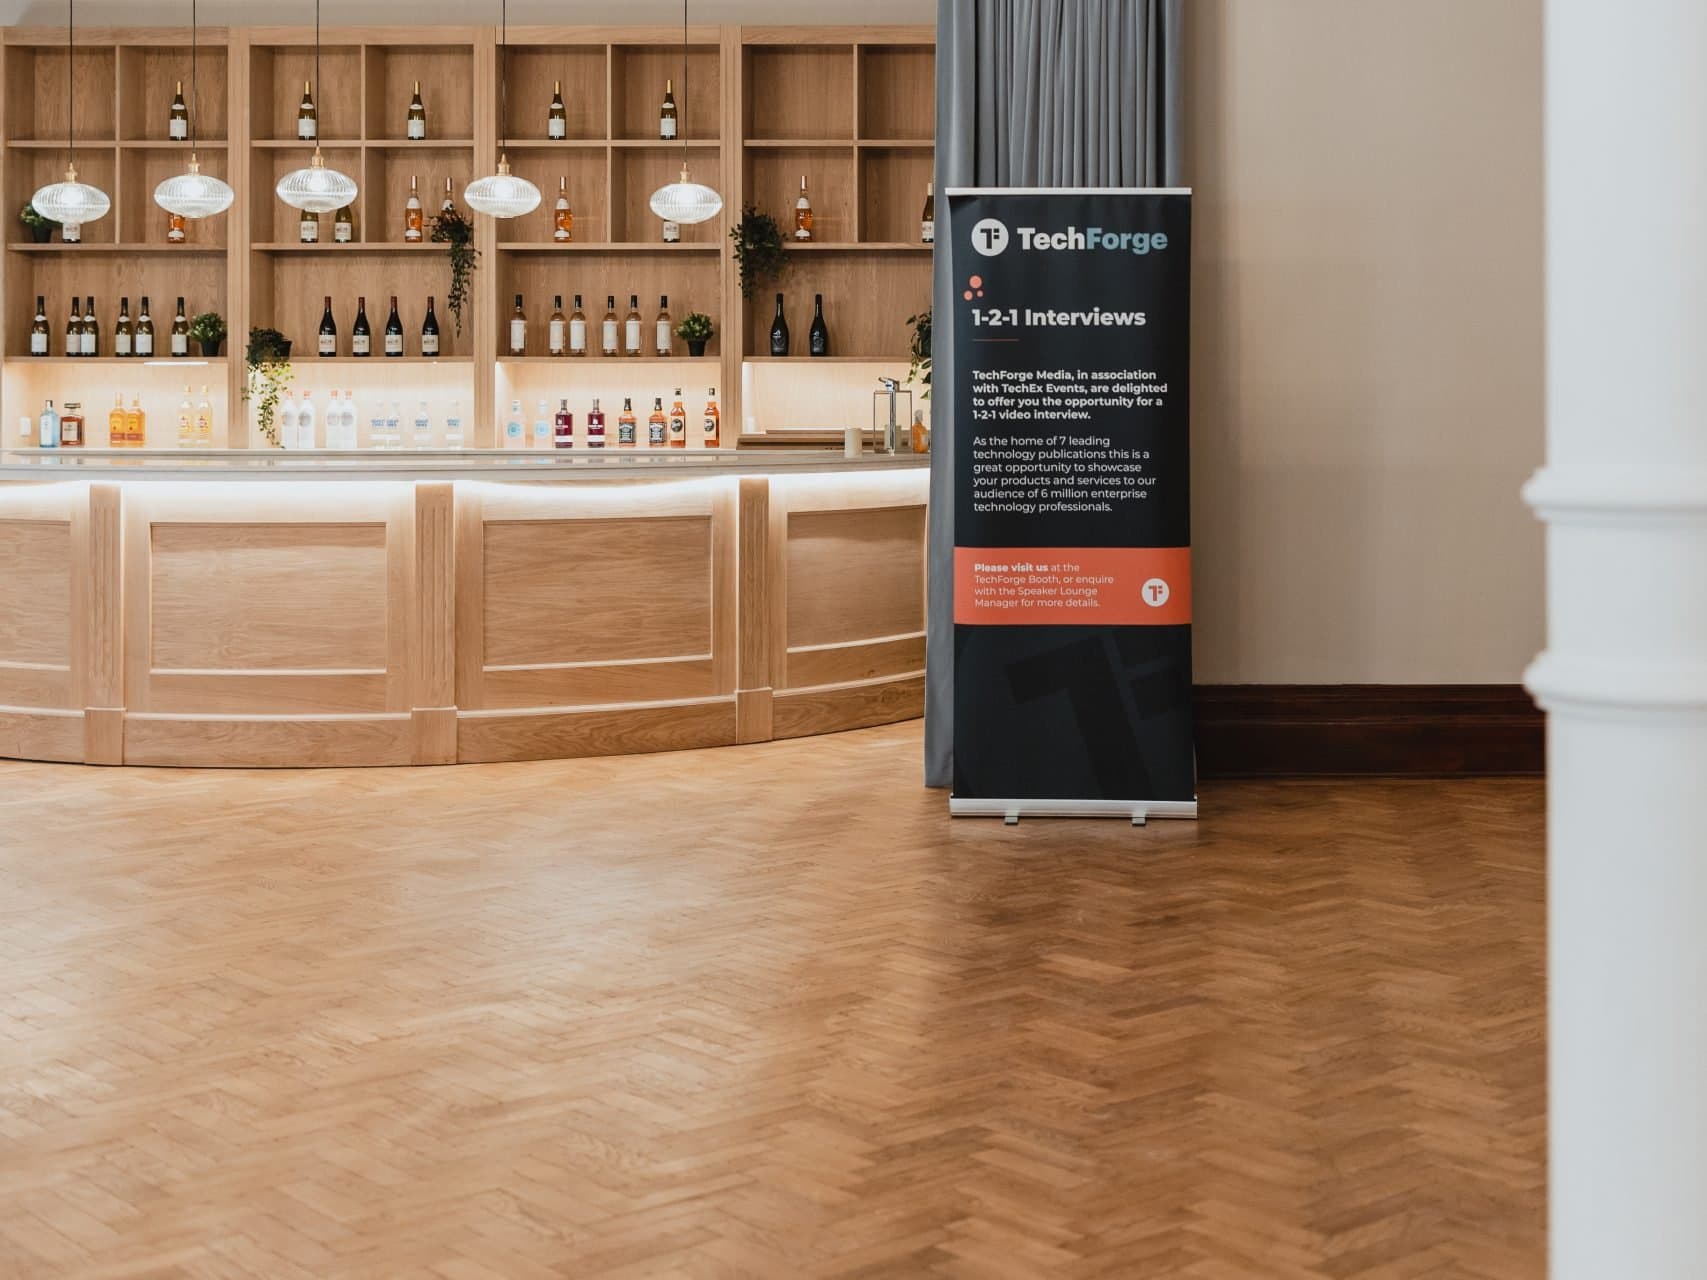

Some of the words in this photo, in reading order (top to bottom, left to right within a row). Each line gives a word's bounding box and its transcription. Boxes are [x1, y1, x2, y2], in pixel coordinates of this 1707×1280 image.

[1017, 226, 1168, 255] TechForge
[971, 309, 1018, 326] 1-2-1
[1025, 307, 1146, 326] Interviews
[973, 371, 1033, 382] TechForge
[1036, 370, 1074, 381] Media,
[1077, 371, 1088, 380] in
[1091, 371, 1156, 380] association
[973, 384, 999, 393] with
[1001, 384, 1043, 393] TechEx
[1046, 384, 1088, 394] Events,
[1112, 383, 1168, 395] delighted
[973, 398, 985, 406] to
[988, 396, 1015, 406] offer
[1018, 399, 1039, 408] you
[1042, 397, 1062, 406] the
[1064, 397, 1134, 408] opportunity
[1136, 396, 1153, 406] for
[973, 410, 996, 419] 1-2-1
[999, 410, 1031, 419] video
[1034, 410, 1091, 419] interview.
[973, 436, 987, 446] As
[989, 436, 1008, 446] the
[1010, 436, 1043, 446] home
[1046, 436, 1058, 446] of
[1059, 437, 1066, 446] 7
[1069, 436, 1110, 448] leading
[973, 449, 1035, 461] technology
[1038, 449, 1107, 461] publications
[1109, 449, 1129, 459] this
[1132, 450, 1141, 459] is
[1143, 451, 1149, 459] a
[973, 464, 1002, 474] great
[1005, 463, 1071, 474] opportunity
[1074, 464, 1085, 472] to
[1088, 462, 1142, 472] showcase
[973, 477, 998, 487] your
[1001, 476, 1050, 487] products
[1053, 476, 1074, 485] and
[1077, 476, 1121, 485] services
[1123, 477, 1135, 485] to
[1137, 477, 1156, 485] our
[973, 489, 1025, 499] audience
[1027, 489, 1039, 498] of
[1041, 489, 1048, 498] 6
[1051, 489, 1088, 498] million
[1091, 489, 1147, 500] enterprise
[973, 502, 1036, 513] technology
[1039, 502, 1113, 513] professionals.
[974, 564, 1008, 573] Please
[1011, 564, 1033, 573] visit
[1036, 565, 1048, 573] us
[1051, 564, 1061, 572] at
[1063, 564, 1080, 572] the
[975, 575, 1026, 586] TechForge
[1029, 575, 1061, 586] Booth,
[1076, 576, 1113, 586] enquire
[975, 587, 996, 595] with
[999, 587, 1016, 595] the
[1018, 587, 1057, 597] Speaker
[1060, 587, 1098, 597] Lounge
[975, 599, 1018, 609] Manager
[1021, 599, 1034, 607] for
[1066, 599, 1100, 607] details.
